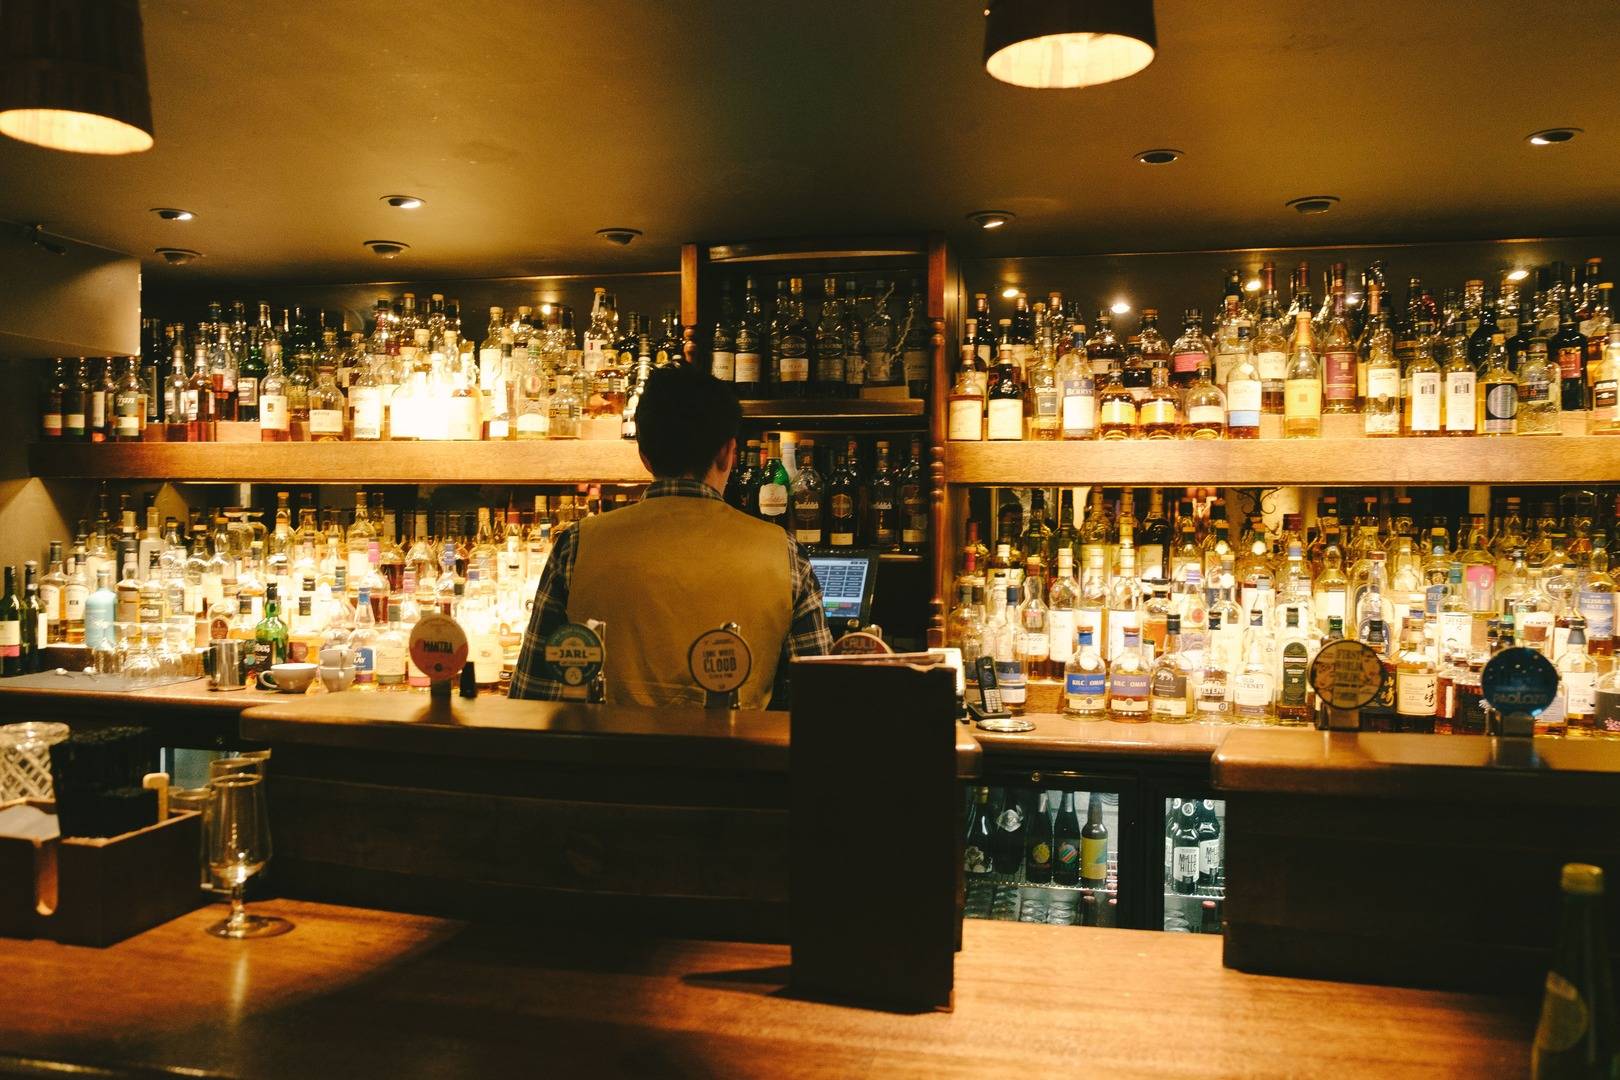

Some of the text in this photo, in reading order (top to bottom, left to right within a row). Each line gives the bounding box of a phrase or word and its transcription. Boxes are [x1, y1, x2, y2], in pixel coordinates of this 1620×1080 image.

[424, 641, 454, 655] MANTRA
[559, 649, 588, 658] JARL
[704, 656, 737, 673] CLOUD
